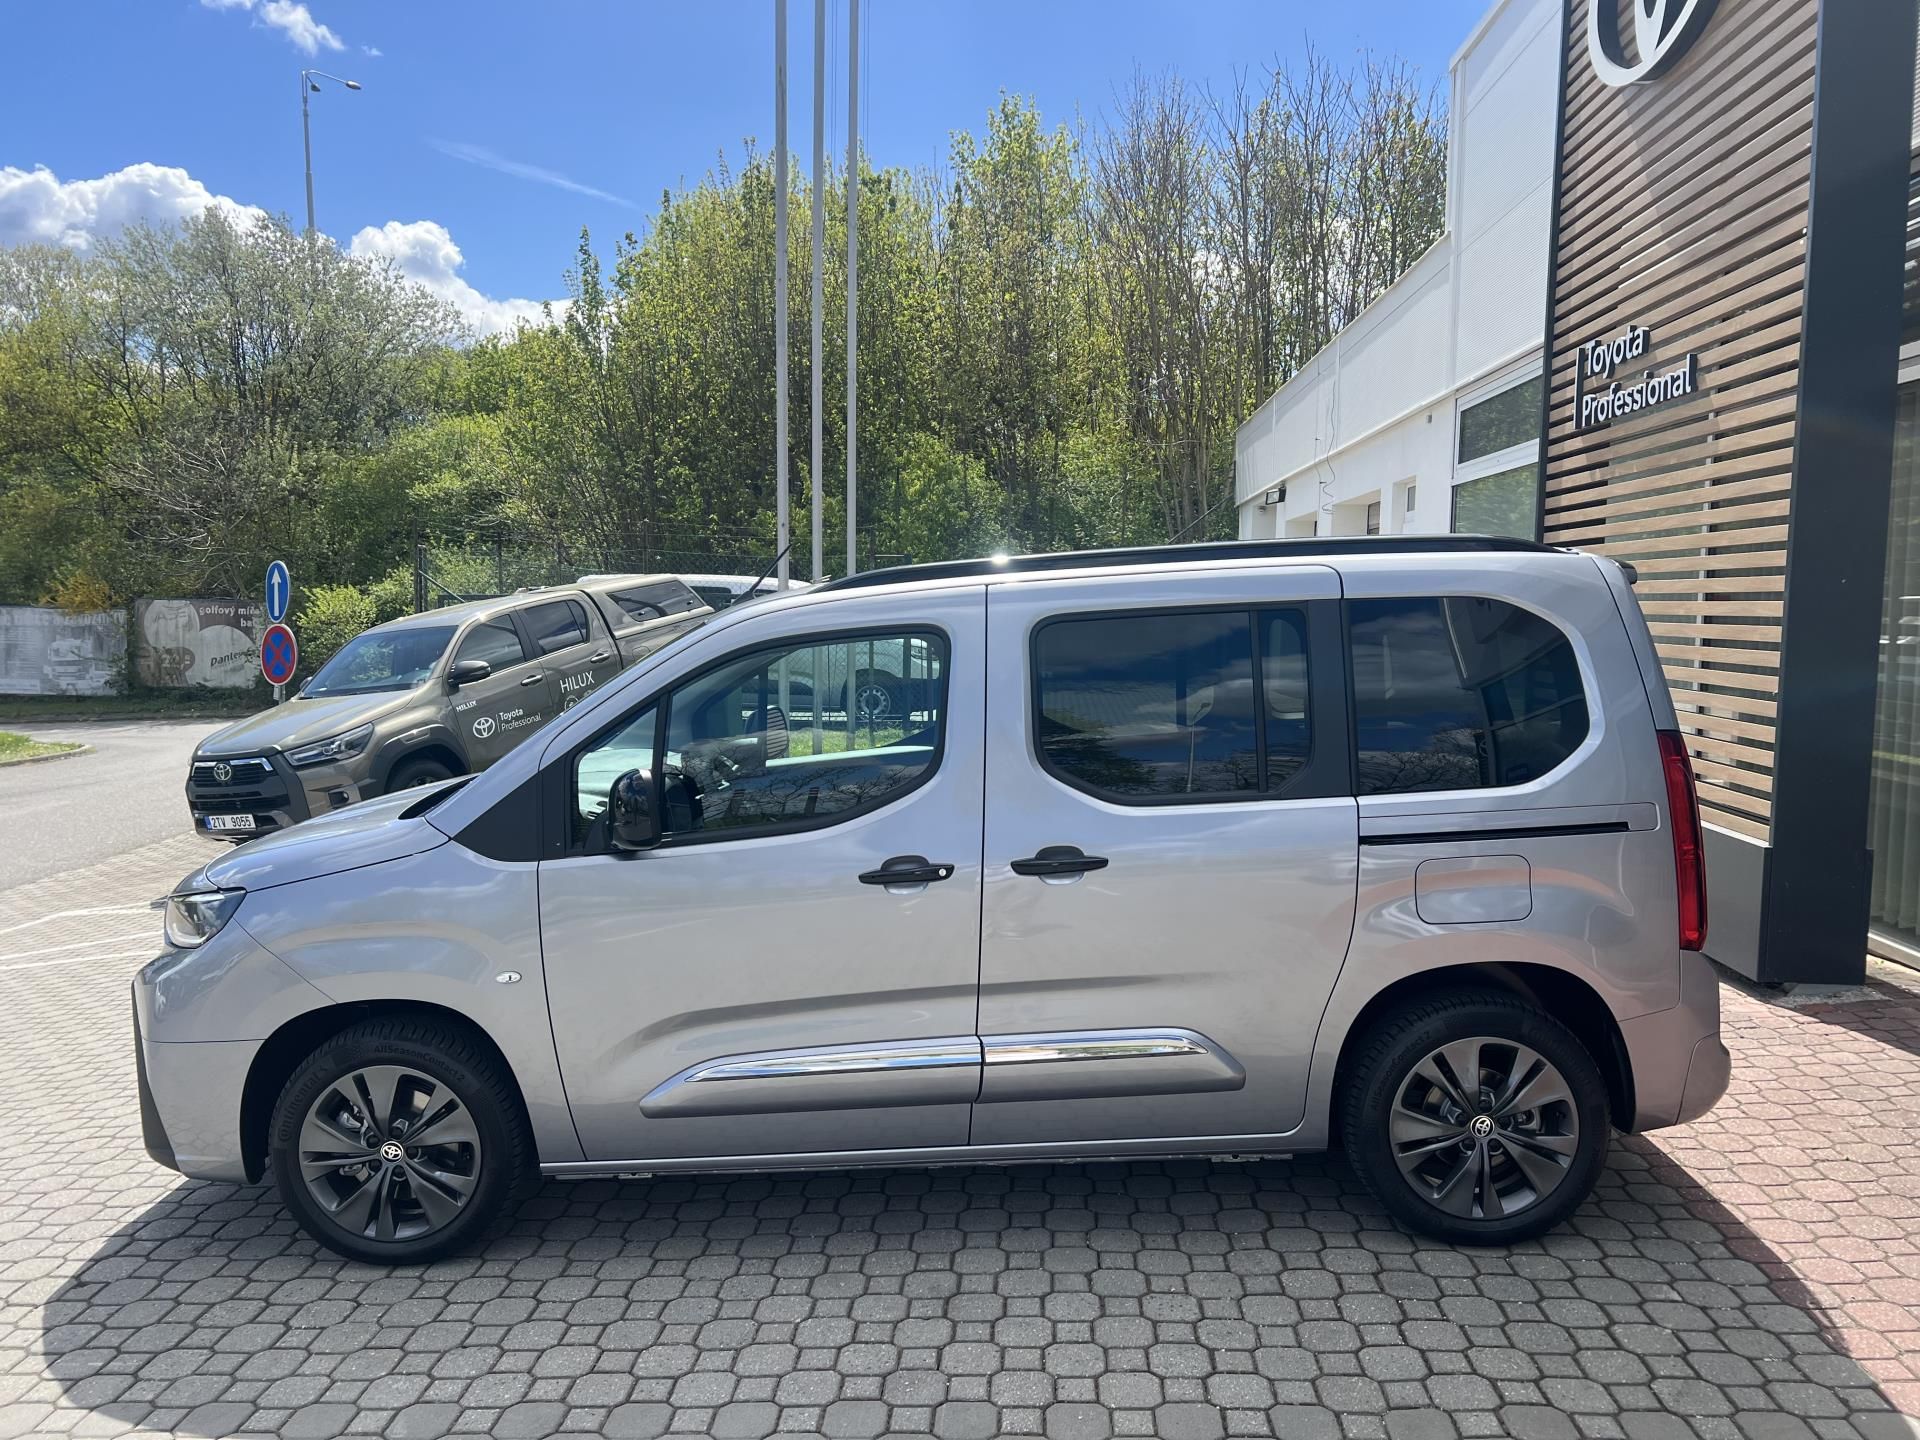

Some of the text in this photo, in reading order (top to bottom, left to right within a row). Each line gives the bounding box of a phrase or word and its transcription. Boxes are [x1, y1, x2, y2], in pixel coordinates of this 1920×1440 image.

[1586, 325, 1650, 379] Toyota
[1582, 353, 1697, 427] Professional
[559, 671, 595, 694] HILUX
[499, 708, 524, 721] Toyota
[501, 712, 542, 732] Professional
[211, 816, 251, 828] 2TV 9055
